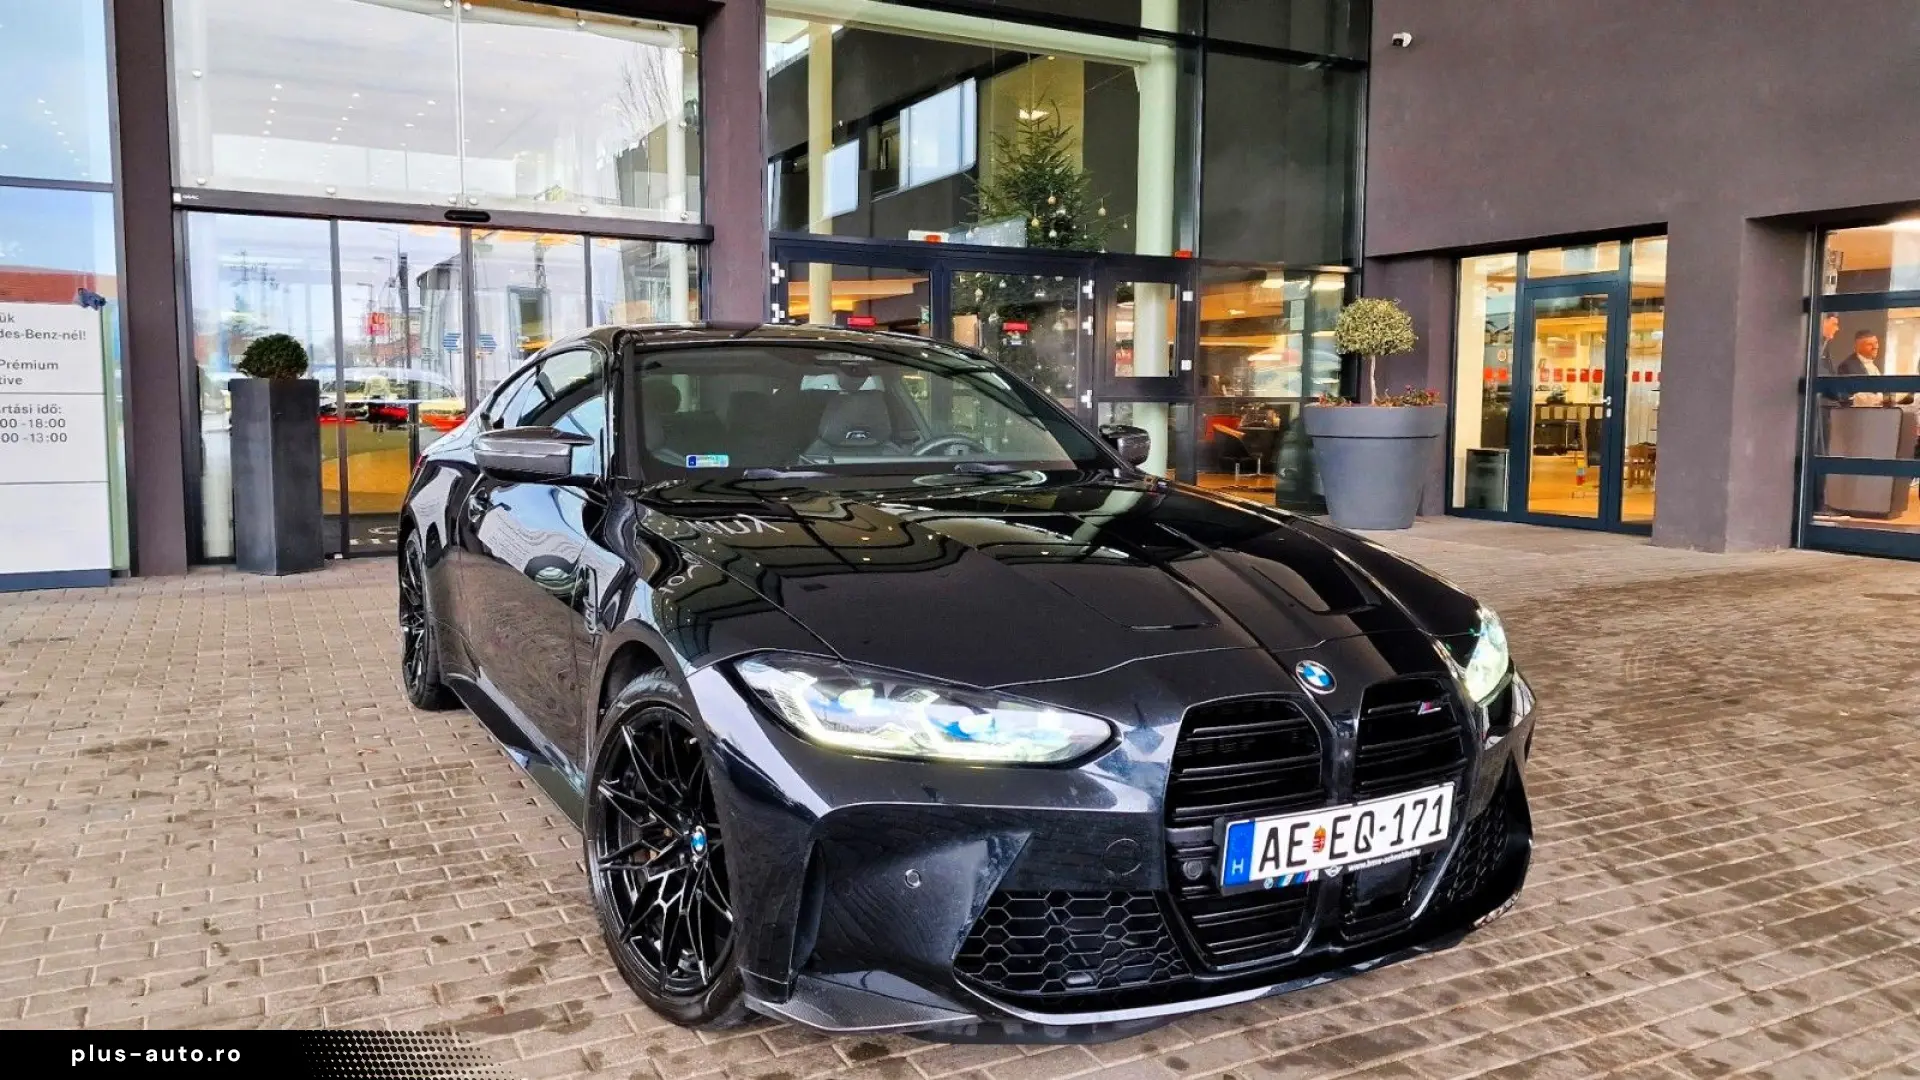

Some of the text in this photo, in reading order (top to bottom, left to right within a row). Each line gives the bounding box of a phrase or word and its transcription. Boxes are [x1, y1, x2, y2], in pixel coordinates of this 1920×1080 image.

[0, 403, 33, 414] rtási
[1259, 821, 1310, 873] AE
[1329, 794, 1445, 860] EQ-171
[1231, 858, 1244, 876] H
